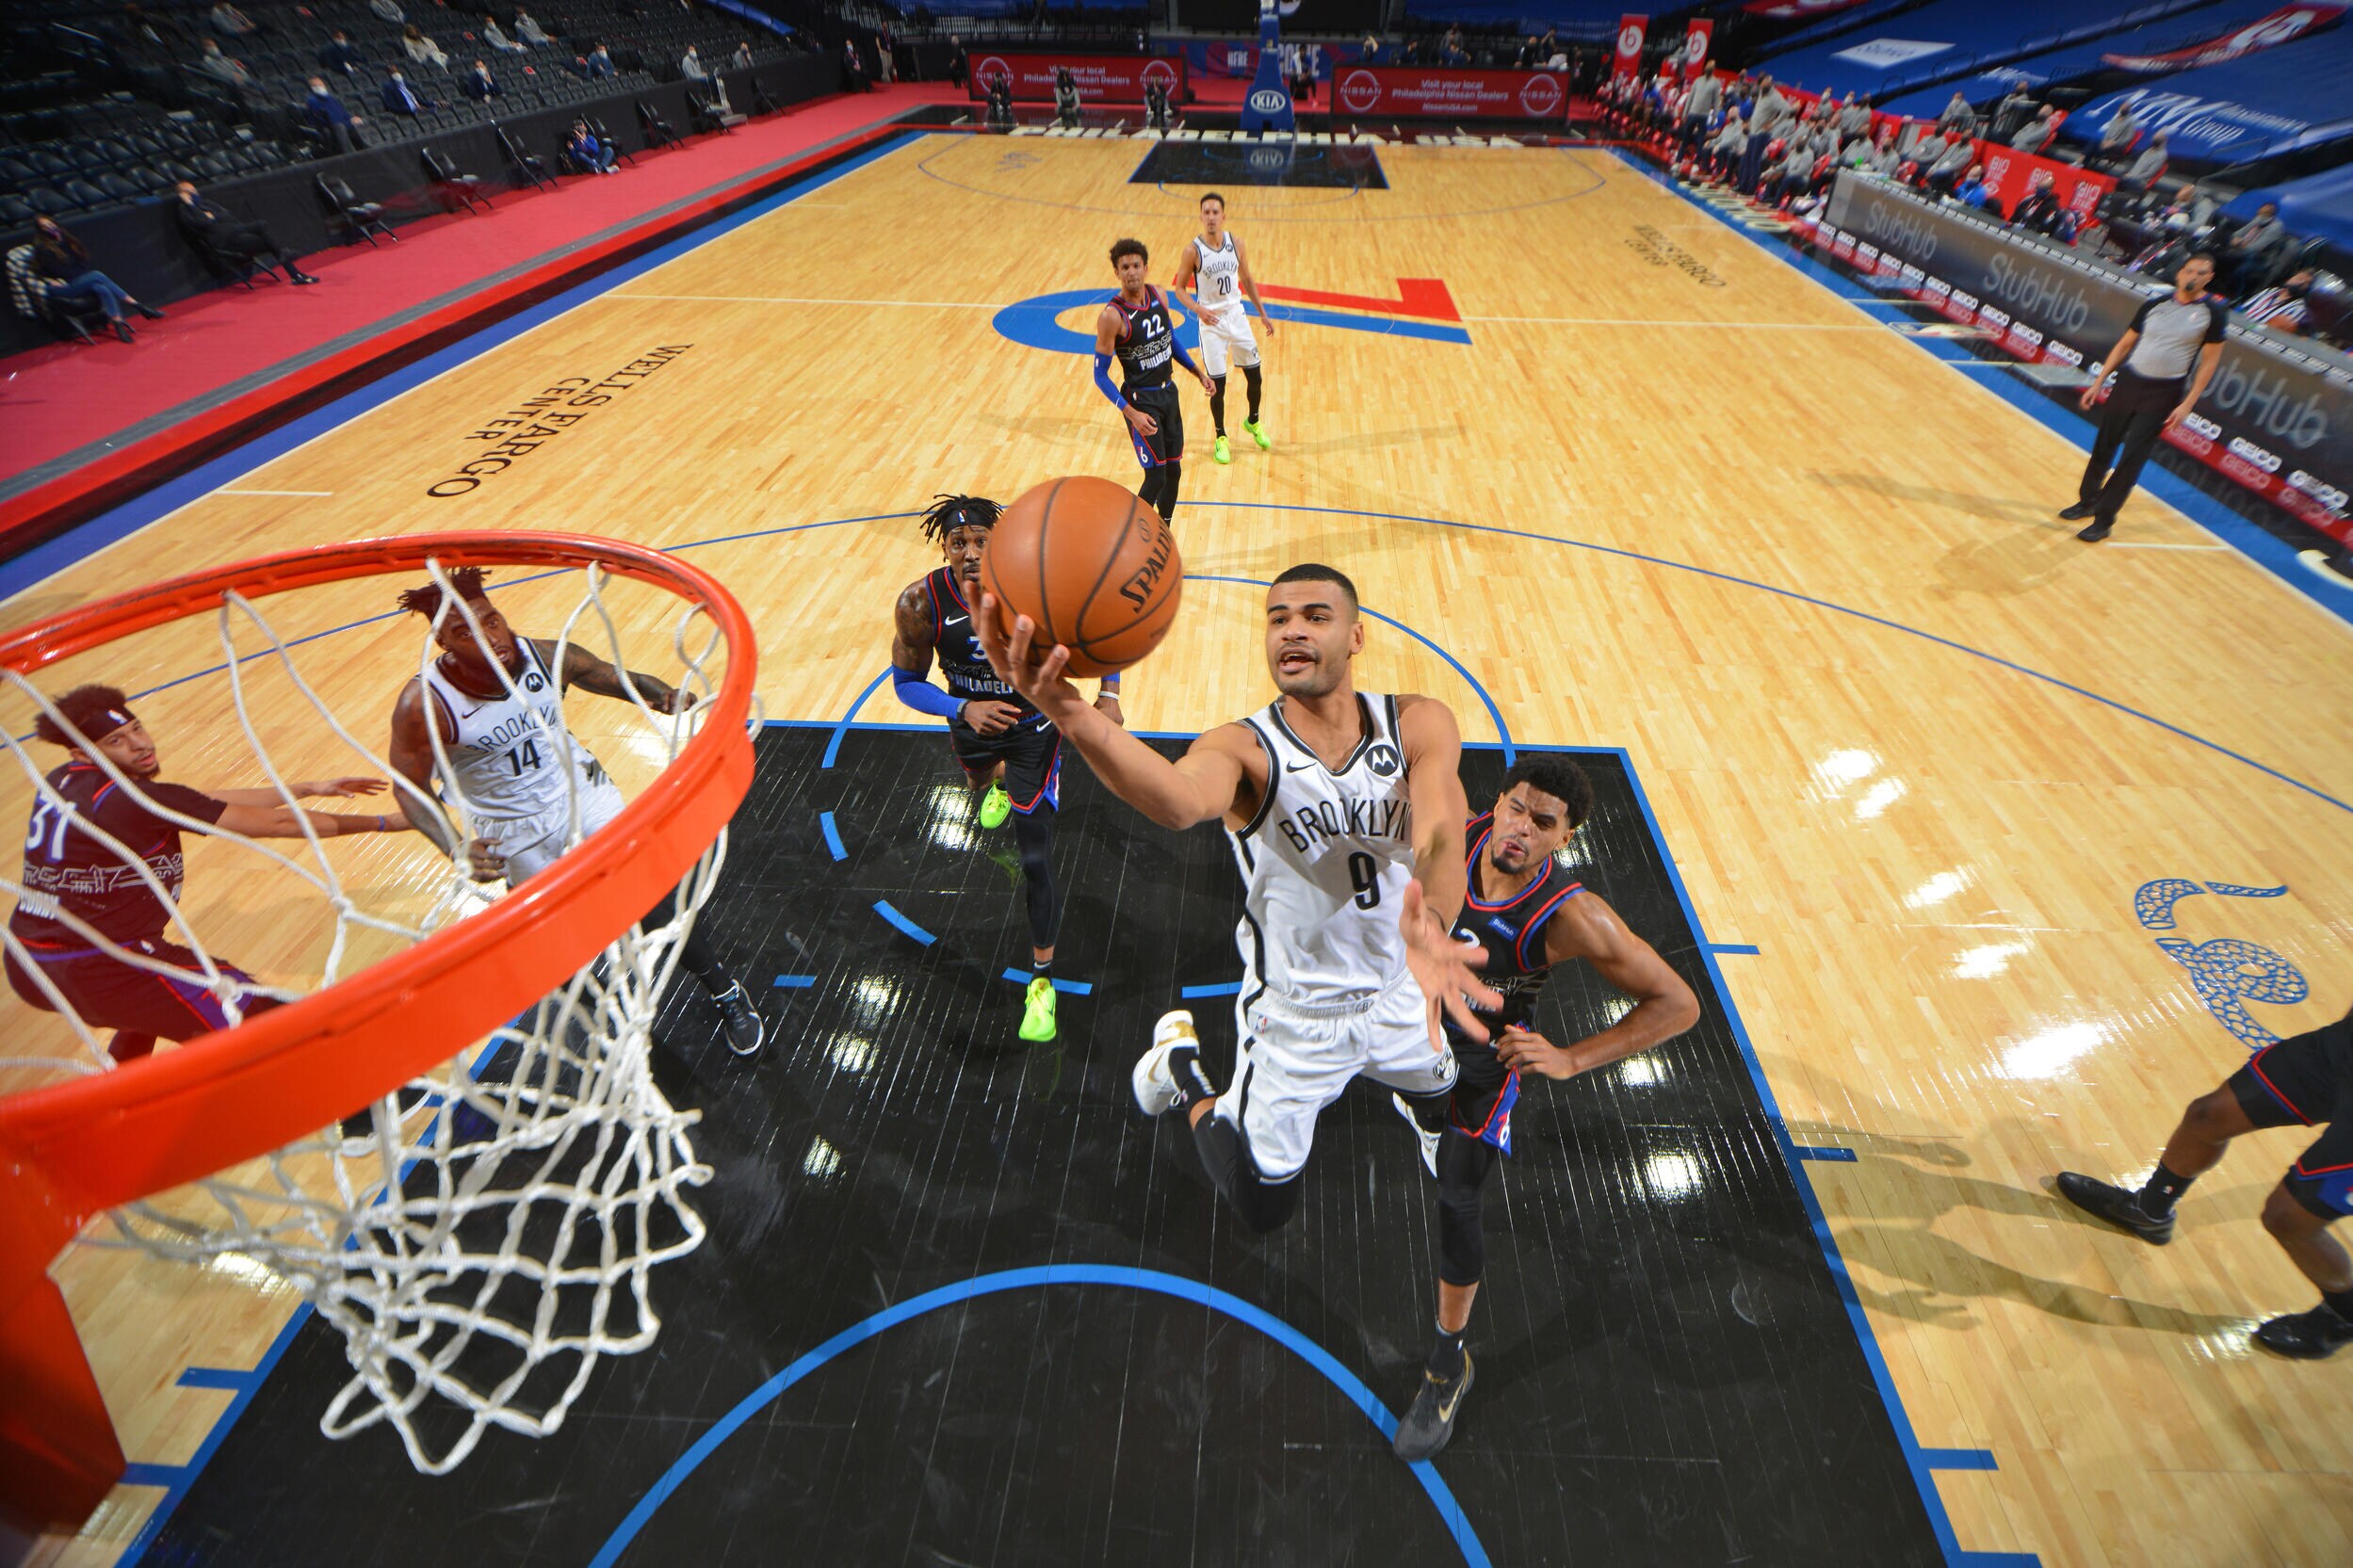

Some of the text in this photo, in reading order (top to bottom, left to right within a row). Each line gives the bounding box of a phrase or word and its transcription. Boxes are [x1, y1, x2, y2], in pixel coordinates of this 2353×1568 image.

[1087, 66, 1106, 75] local
[1100, 75, 1130, 85] Dealers
[1339, 86, 1382, 95] NISSAN
[1392, 88, 1509, 102] Philadelphia Nissan Dealers
[1420, 78, 1484, 91] Visit your local
[1519, 90, 1562, 100] NISSAN
[1865, 201, 1938, 261] StubHub
[1217, 275, 1231, 296] 20
[1925, 275, 1952, 297] GEICO
[1983, 251, 2089, 332] StubHub
[1952, 288, 1979, 311] GEICO
[1143, 314, 1165, 339] 22
[1980, 303, 2011, 328] GEICO
[2012, 321, 2044, 347] GEICO
[2047, 339, 2084, 366] GEICO
[465, 377, 591, 441] CENTER
[2186, 354, 2329, 449] ubHub
[426, 343, 695, 497] WELLS FARGO
[2185, 412, 2222, 441] EICO
[2227, 436, 2283, 474] GEICO
[2286, 469, 2350, 509] GEICO
[505, 738, 542, 777] 14
[1348, 851, 1381, 911] 9
[1493, 918, 1515, 937] StubHub
